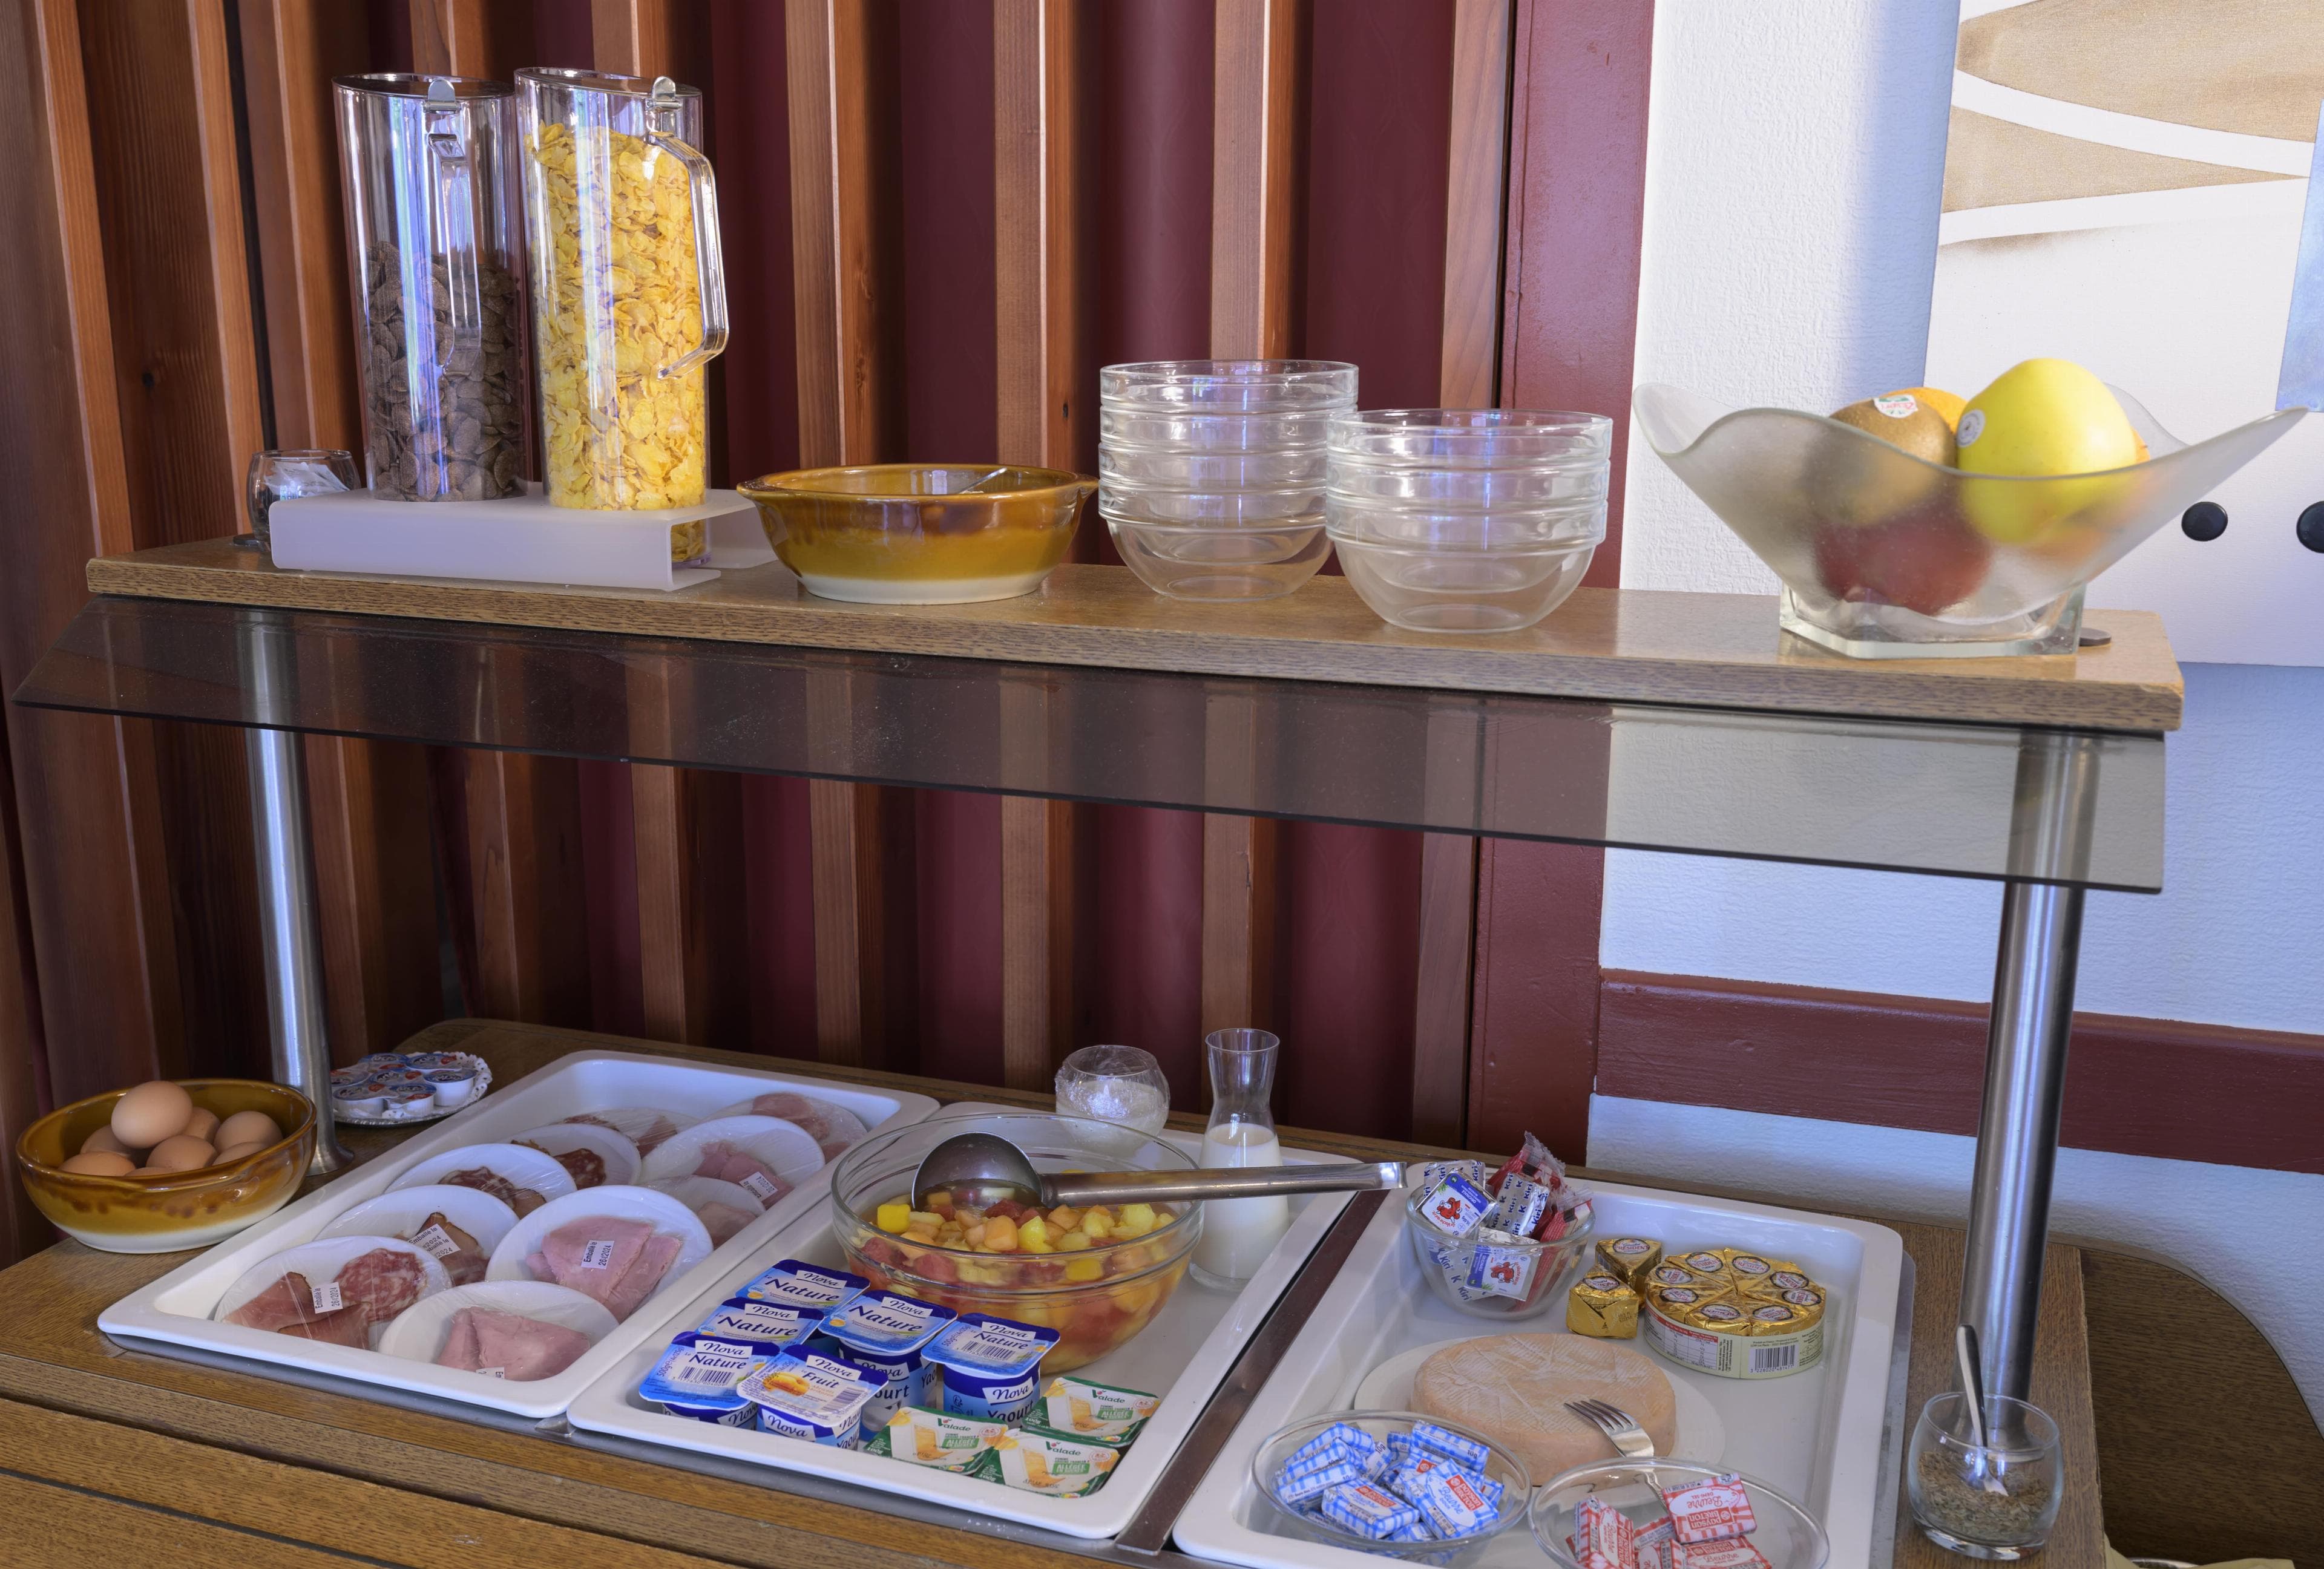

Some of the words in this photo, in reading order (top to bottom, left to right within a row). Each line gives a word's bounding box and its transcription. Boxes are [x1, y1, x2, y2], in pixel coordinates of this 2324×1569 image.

[1505, 1174, 1514, 1190] Kiri
[1524, 1184, 1533, 1199] Kiri
[1508, 1198, 1517, 1213] Kiri
[1491, 1213, 1500, 1228] Kiri
[1439, 1256, 1454, 1269] Kiri
[804, 1273, 839, 1286] Nova
[765, 1278, 840, 1302] Nature
[1458, 1286, 1472, 1300] Kiri
[753, 1306, 791, 1318] Nova
[890, 1300, 925, 1315] Nova
[718, 1316, 798, 1336] Nature
[849, 1305, 923, 1332] Nature
[990, 1324, 1028, 1338] Nova
[973, 1332, 1029, 1349] Nature
[704, 1342, 745, 1356] Nova
[689, 1354, 747, 1370] Nature
[815, 1358, 853, 1377] Nova
[802, 1372, 839, 1388] Fruit
[993, 1384, 1030, 1401] Nova
[1092, 1389, 1126, 1404] Valade
[768, 1415, 808, 1438] Nova
[937, 1417, 971, 1432] Valade
[1046, 1441, 1082, 1456] Valade
[1374, 1443, 1387, 1453] 10g
[1467, 1449, 1478, 1459] 10g
[1438, 1486, 1463, 1514] Beurre
[1460, 1483, 1480, 1506] paysan
[1687, 1496, 1723, 1508] Beurre
[1687, 1510, 1720, 1521] BRETON
[1691, 1518, 1722, 1529] paysan
